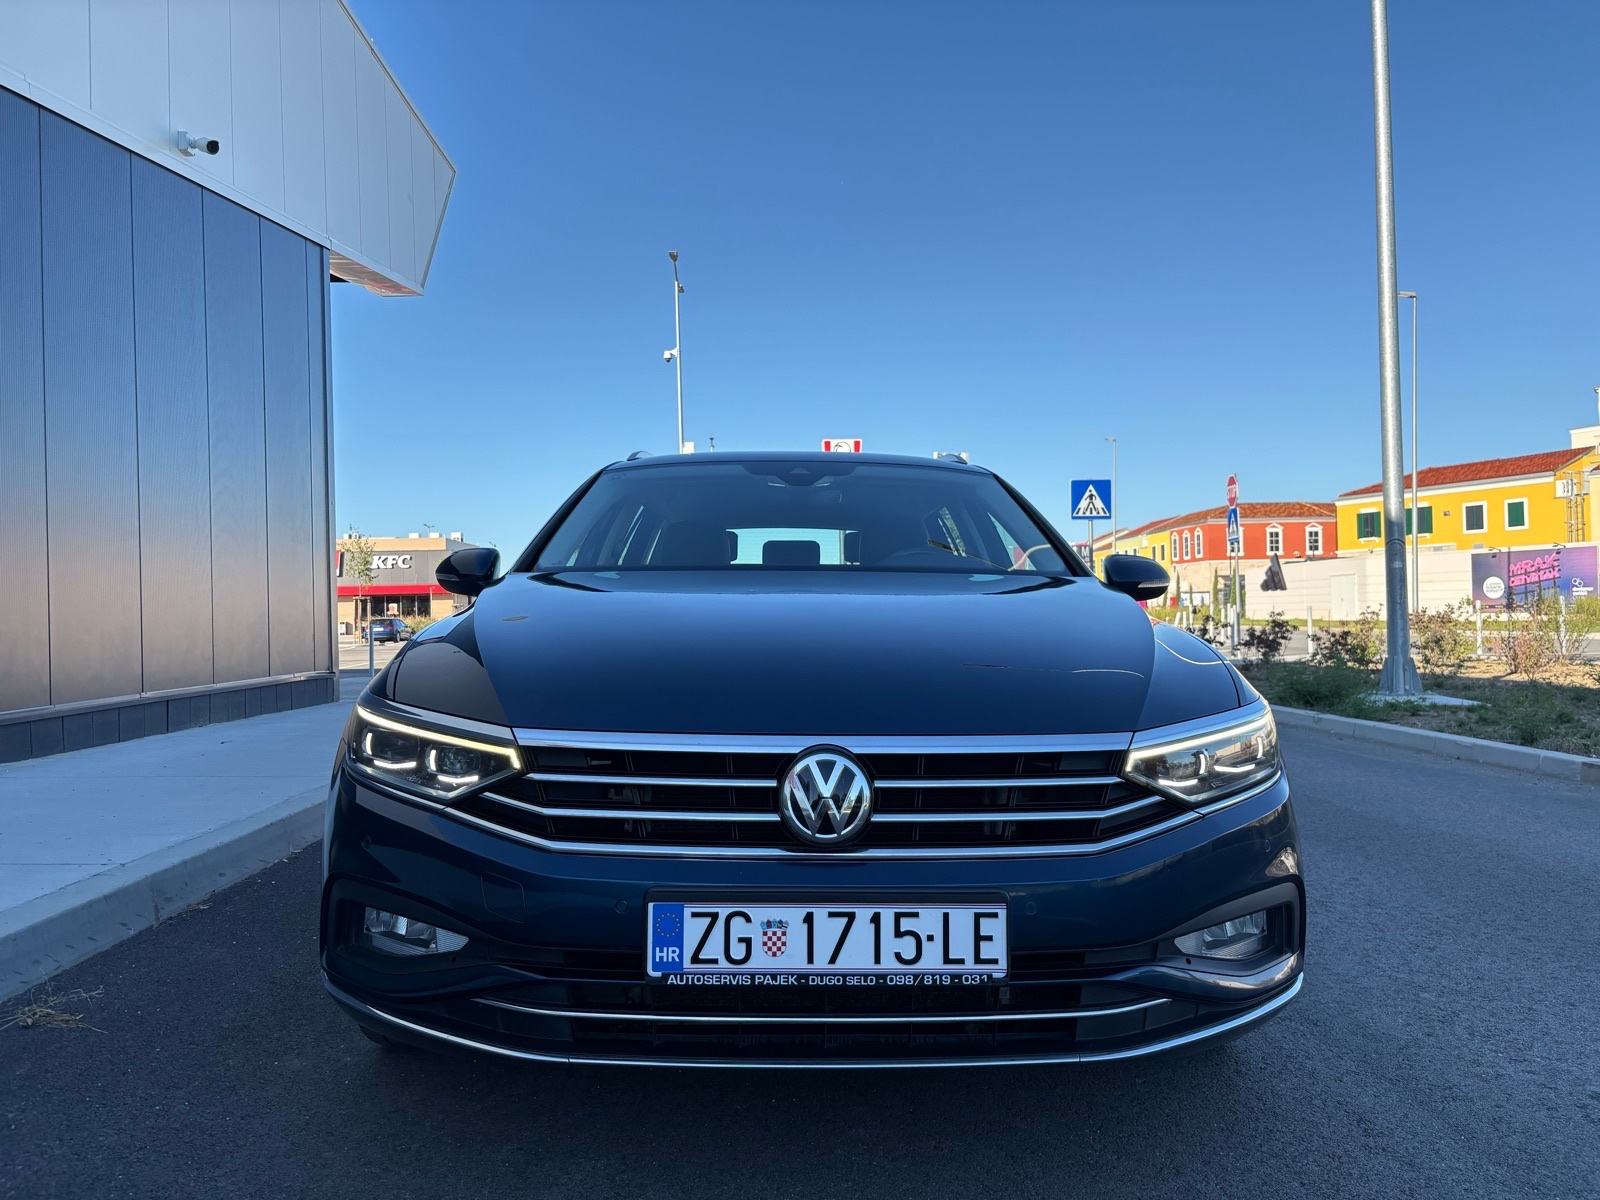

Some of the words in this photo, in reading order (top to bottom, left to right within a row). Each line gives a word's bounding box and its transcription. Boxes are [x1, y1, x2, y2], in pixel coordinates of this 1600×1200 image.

[369, 555, 411, 568] KFC
[690, 911, 753, 965] ZG
[655, 946, 680, 963] HR
[667, 974, 751, 985] AUTOSERVIS
[755, 974, 798, 985] PAJEK
[809, 975, 843, 985] DUGO
[846, 975, 876, 985] SELO
[886, 974, 951, 986] 098/819
[962, 974, 987, 985] 031
